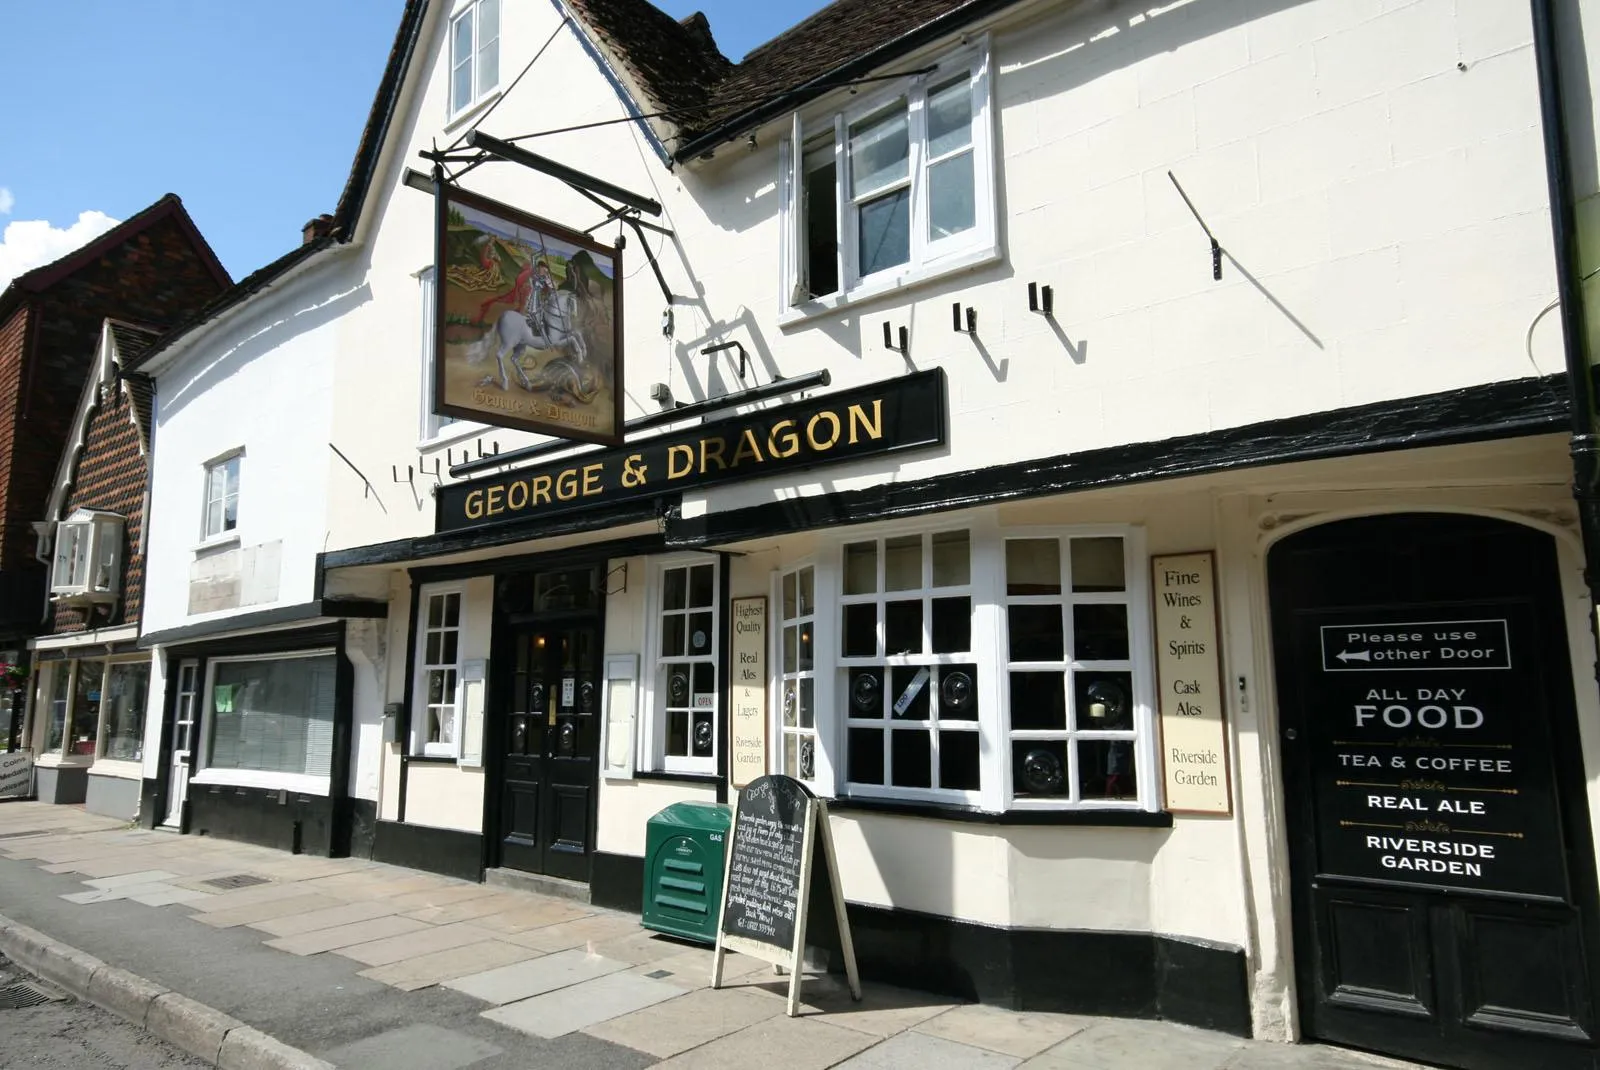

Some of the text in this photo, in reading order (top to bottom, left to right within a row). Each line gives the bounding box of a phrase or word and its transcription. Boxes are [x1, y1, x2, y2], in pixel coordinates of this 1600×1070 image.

[472, 389, 596, 427] George & Dragon
[464, 399, 883, 519] GEORGE & DRAGON
[1165, 570, 1201, 587] Fine
[1163, 592, 1202, 608] Wines
[735, 603, 763, 619] Highest
[736, 620, 761, 635] Quality
[1180, 615, 1192, 629] &
[1348, 631, 1477, 643] Please use
[740, 651, 758, 664] Real
[1169, 640, 1205, 660] Spirits
[1373, 647, 1495, 661] other Door
[740, 668, 757, 680] Ales
[744, 688, 751, 698] &
[1173, 679, 1201, 695] Cask
[1366, 688, 1466, 701] ALL DAY
[697, 697, 712, 706] OPEN
[1176, 701, 1202, 716] Ales
[737, 703, 759, 720] Lagers
[1354, 705, 1484, 729] FOOD
[735, 736, 762, 748] Riverside
[736, 752, 762, 764] Garden
[1172, 748, 1217, 764] Riverside
[1338, 754, 1512, 772] TEA & COFFEE
[1174, 770, 1218, 786] Garden
[1367, 795, 1485, 815] REAL ALE
[709, 833, 722, 842] GAS
[1366, 835, 1496, 859] RIVERSIDE
[1381, 855, 1482, 877] GARDEN
